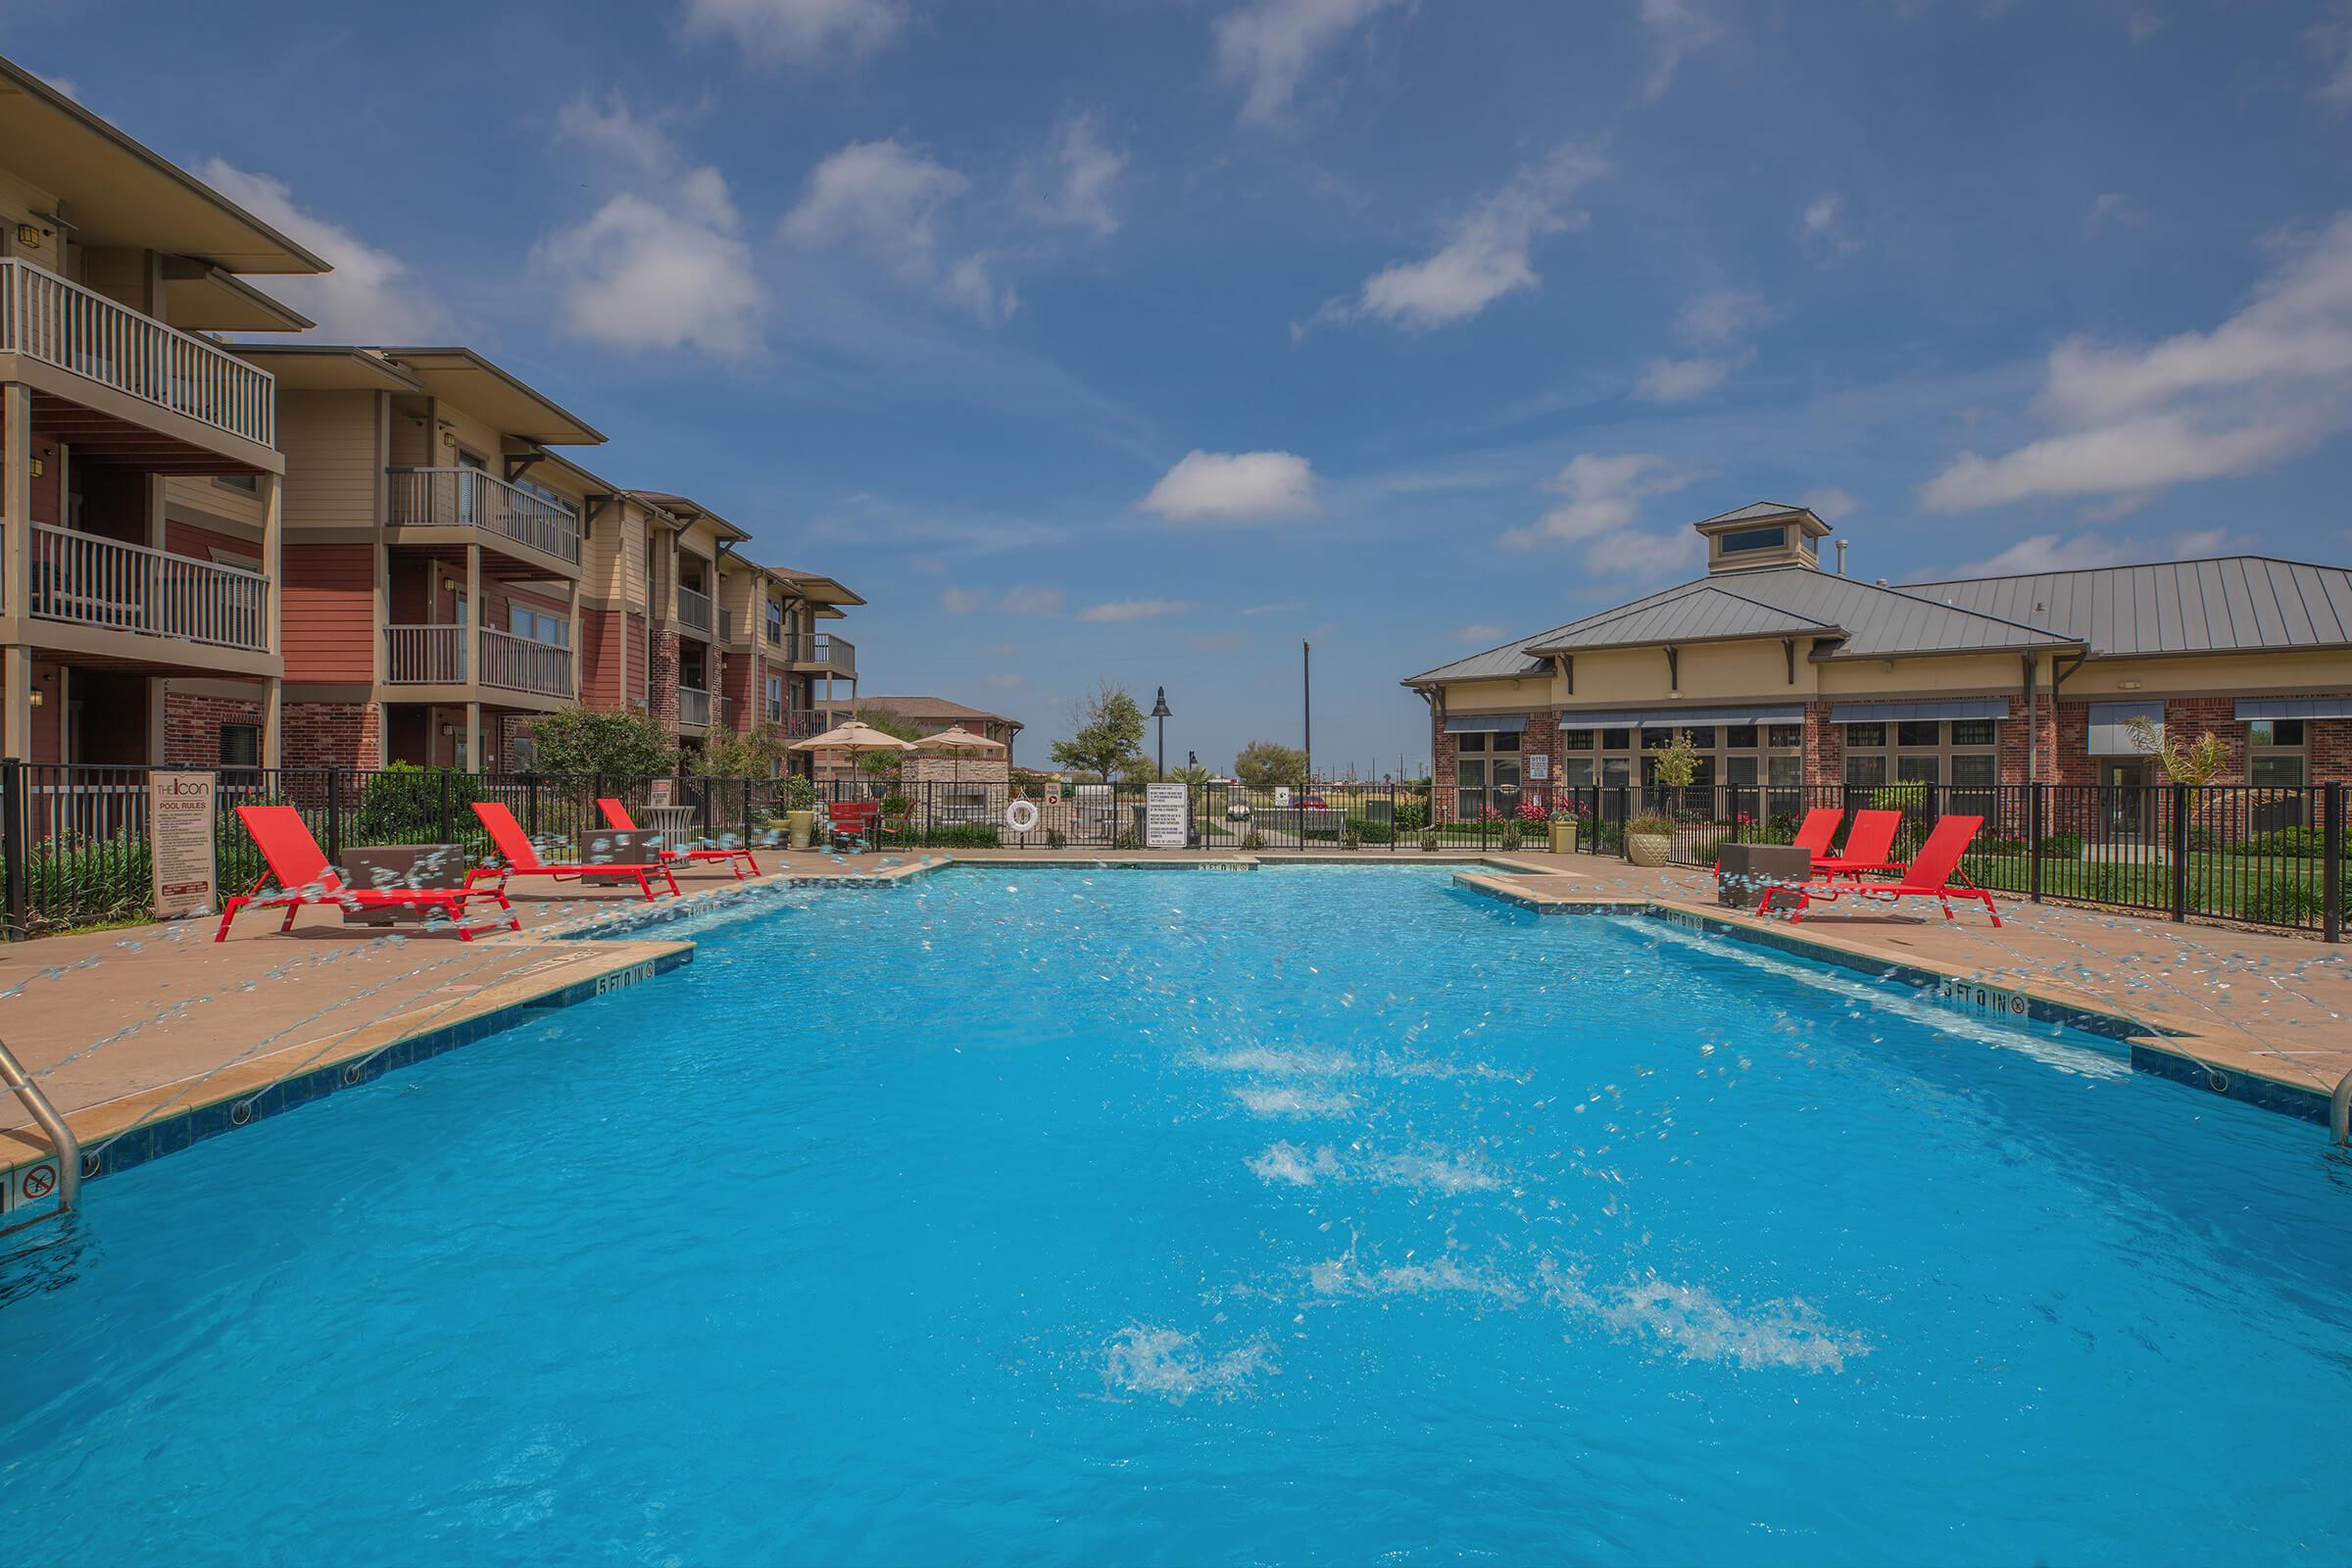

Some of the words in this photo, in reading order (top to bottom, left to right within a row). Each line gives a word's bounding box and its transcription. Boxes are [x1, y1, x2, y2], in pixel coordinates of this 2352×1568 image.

[158, 785, 172, 795] THE
[600, 979, 607, 995] 5
[611, 974, 621, 991] FT
[634, 966, 643, 985] IN
[1957, 983, 1972, 1003] FT
[1992, 992, 2006, 1012] IN
